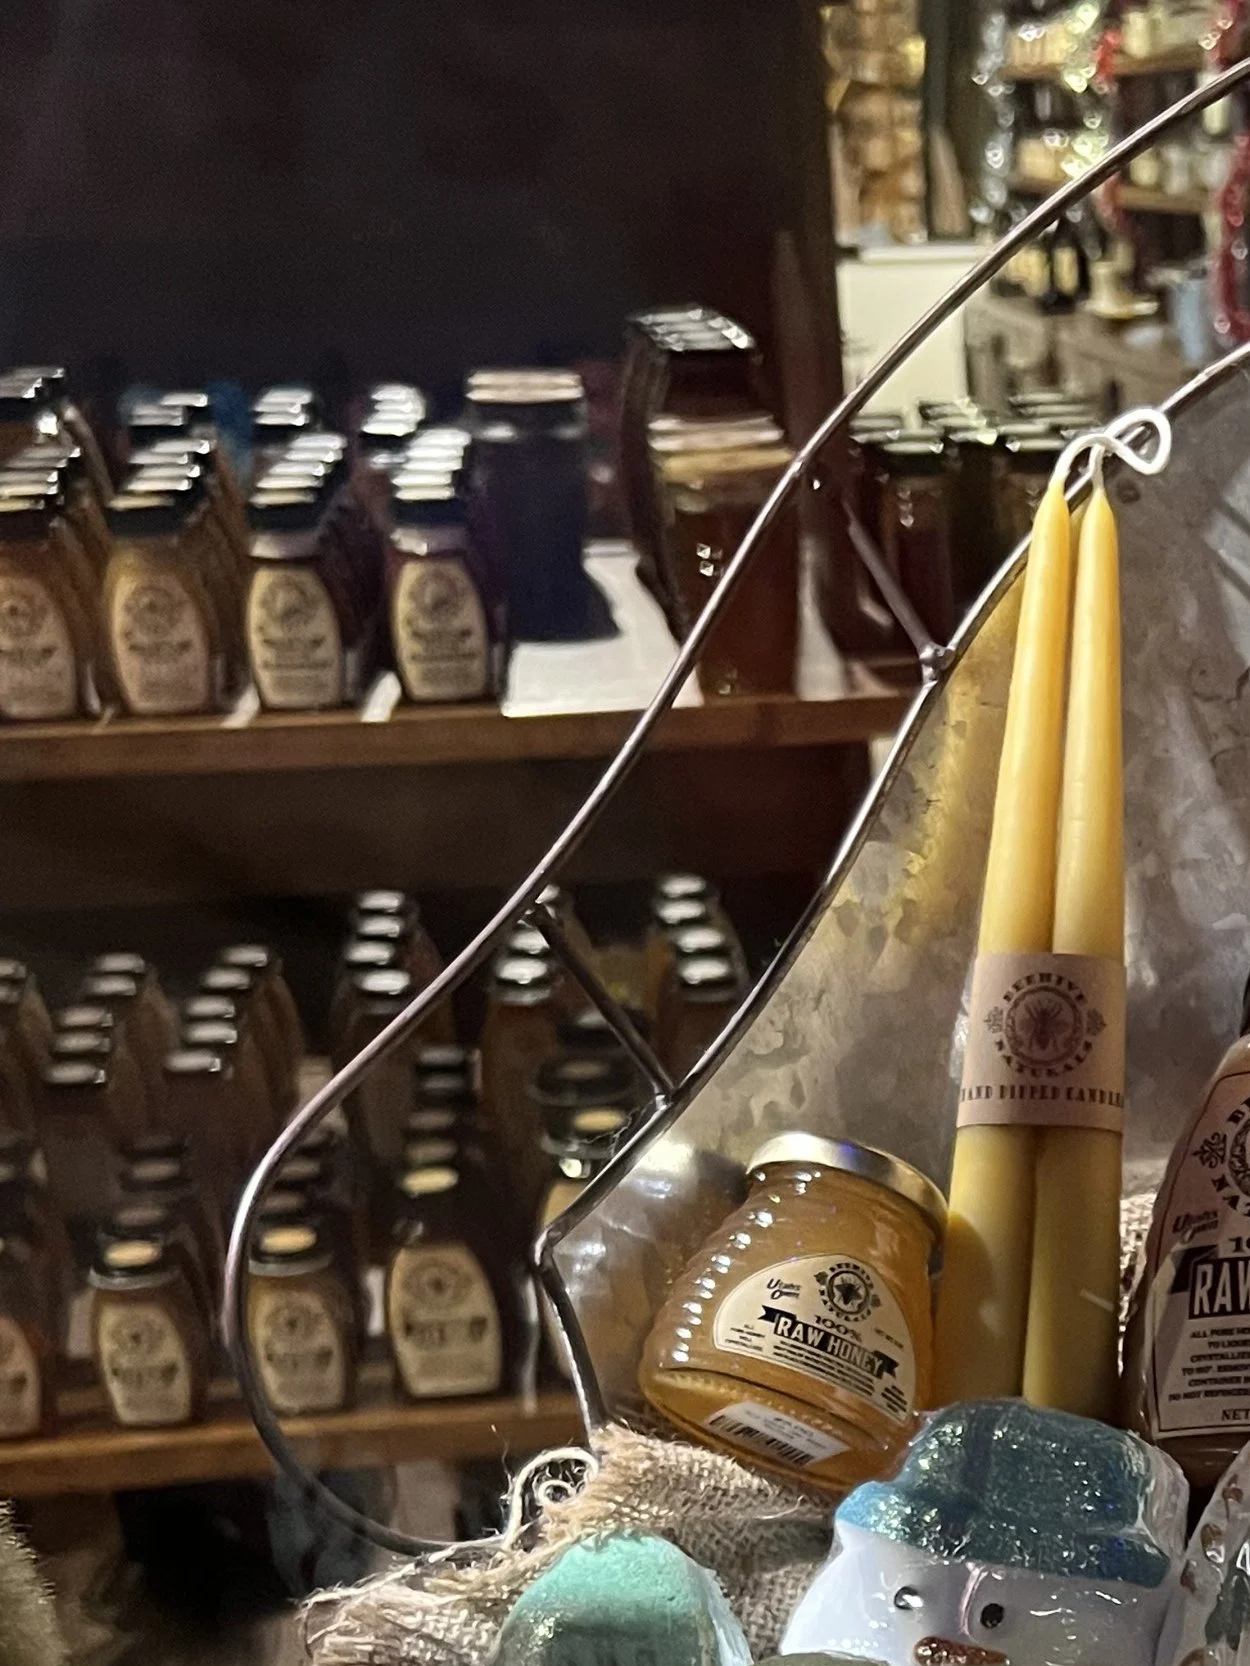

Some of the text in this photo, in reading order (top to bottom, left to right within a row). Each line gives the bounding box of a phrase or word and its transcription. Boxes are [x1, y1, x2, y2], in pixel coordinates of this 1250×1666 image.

[778, 1316, 824, 1349] RAW
[827, 1336, 884, 1376] HONEY
[815, 1313, 863, 1343] 100%
